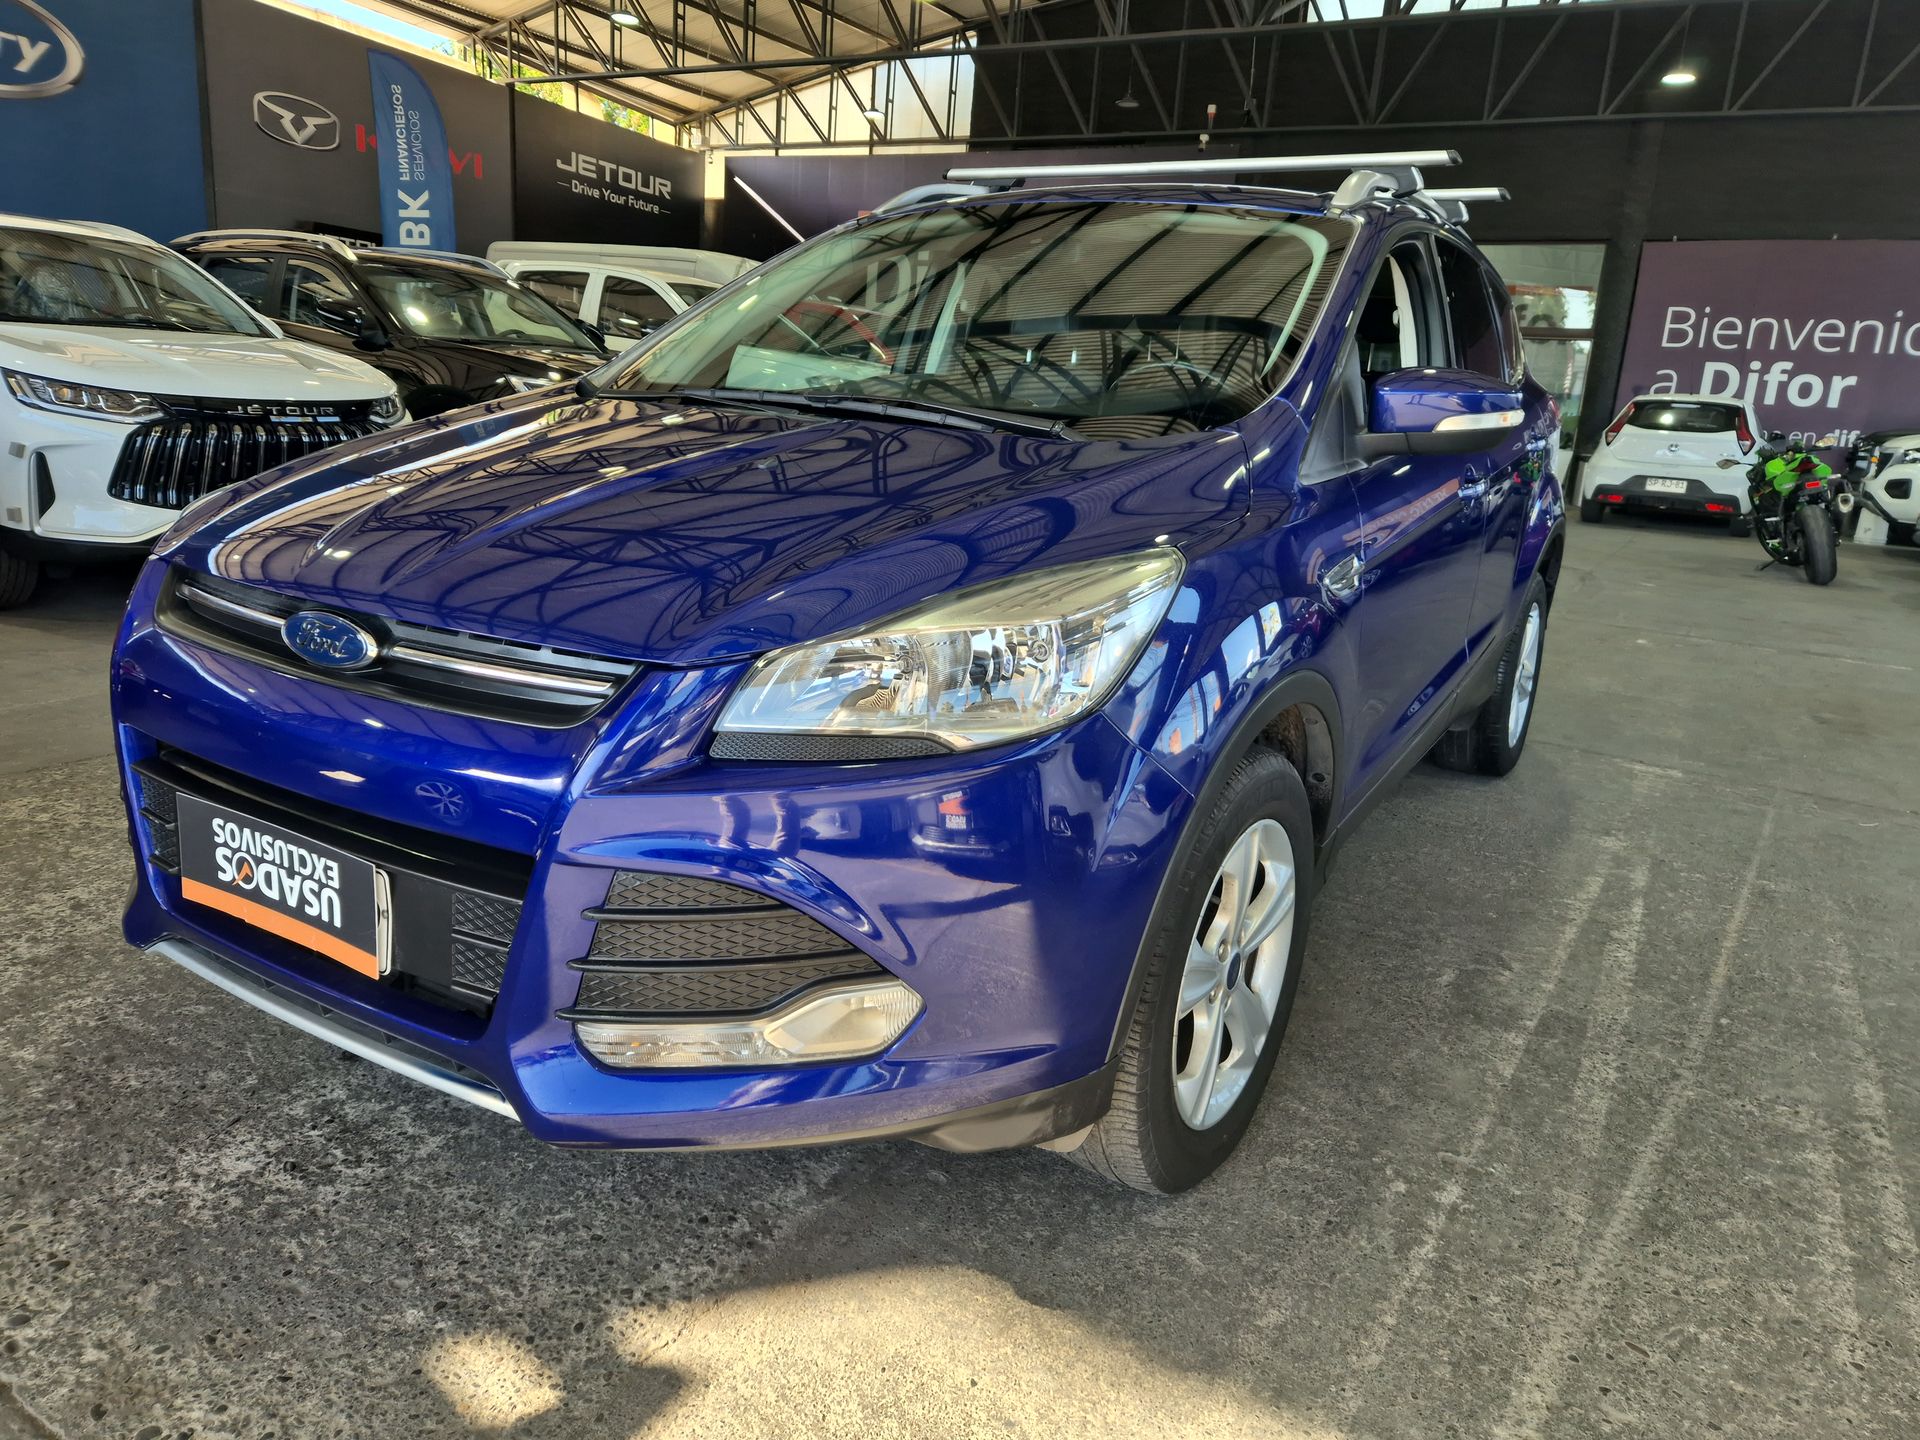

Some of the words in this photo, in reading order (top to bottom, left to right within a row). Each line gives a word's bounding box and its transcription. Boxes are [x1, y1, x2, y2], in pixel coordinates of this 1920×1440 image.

[556, 151, 672, 200] JETOUR
[571, 179, 600, 199] Drive
[602, 187, 627, 206] Your
[628, 194, 660, 214] Future
[1649, 368, 1678, 395] a
[1699, 360, 1858, 409] Difor
[226, 405, 334, 415] JETOUR
[296, 618, 351, 658] Ford
[211, 817, 340, 890] EXCLUSIVOS
[215, 846, 342, 928] USADOS
